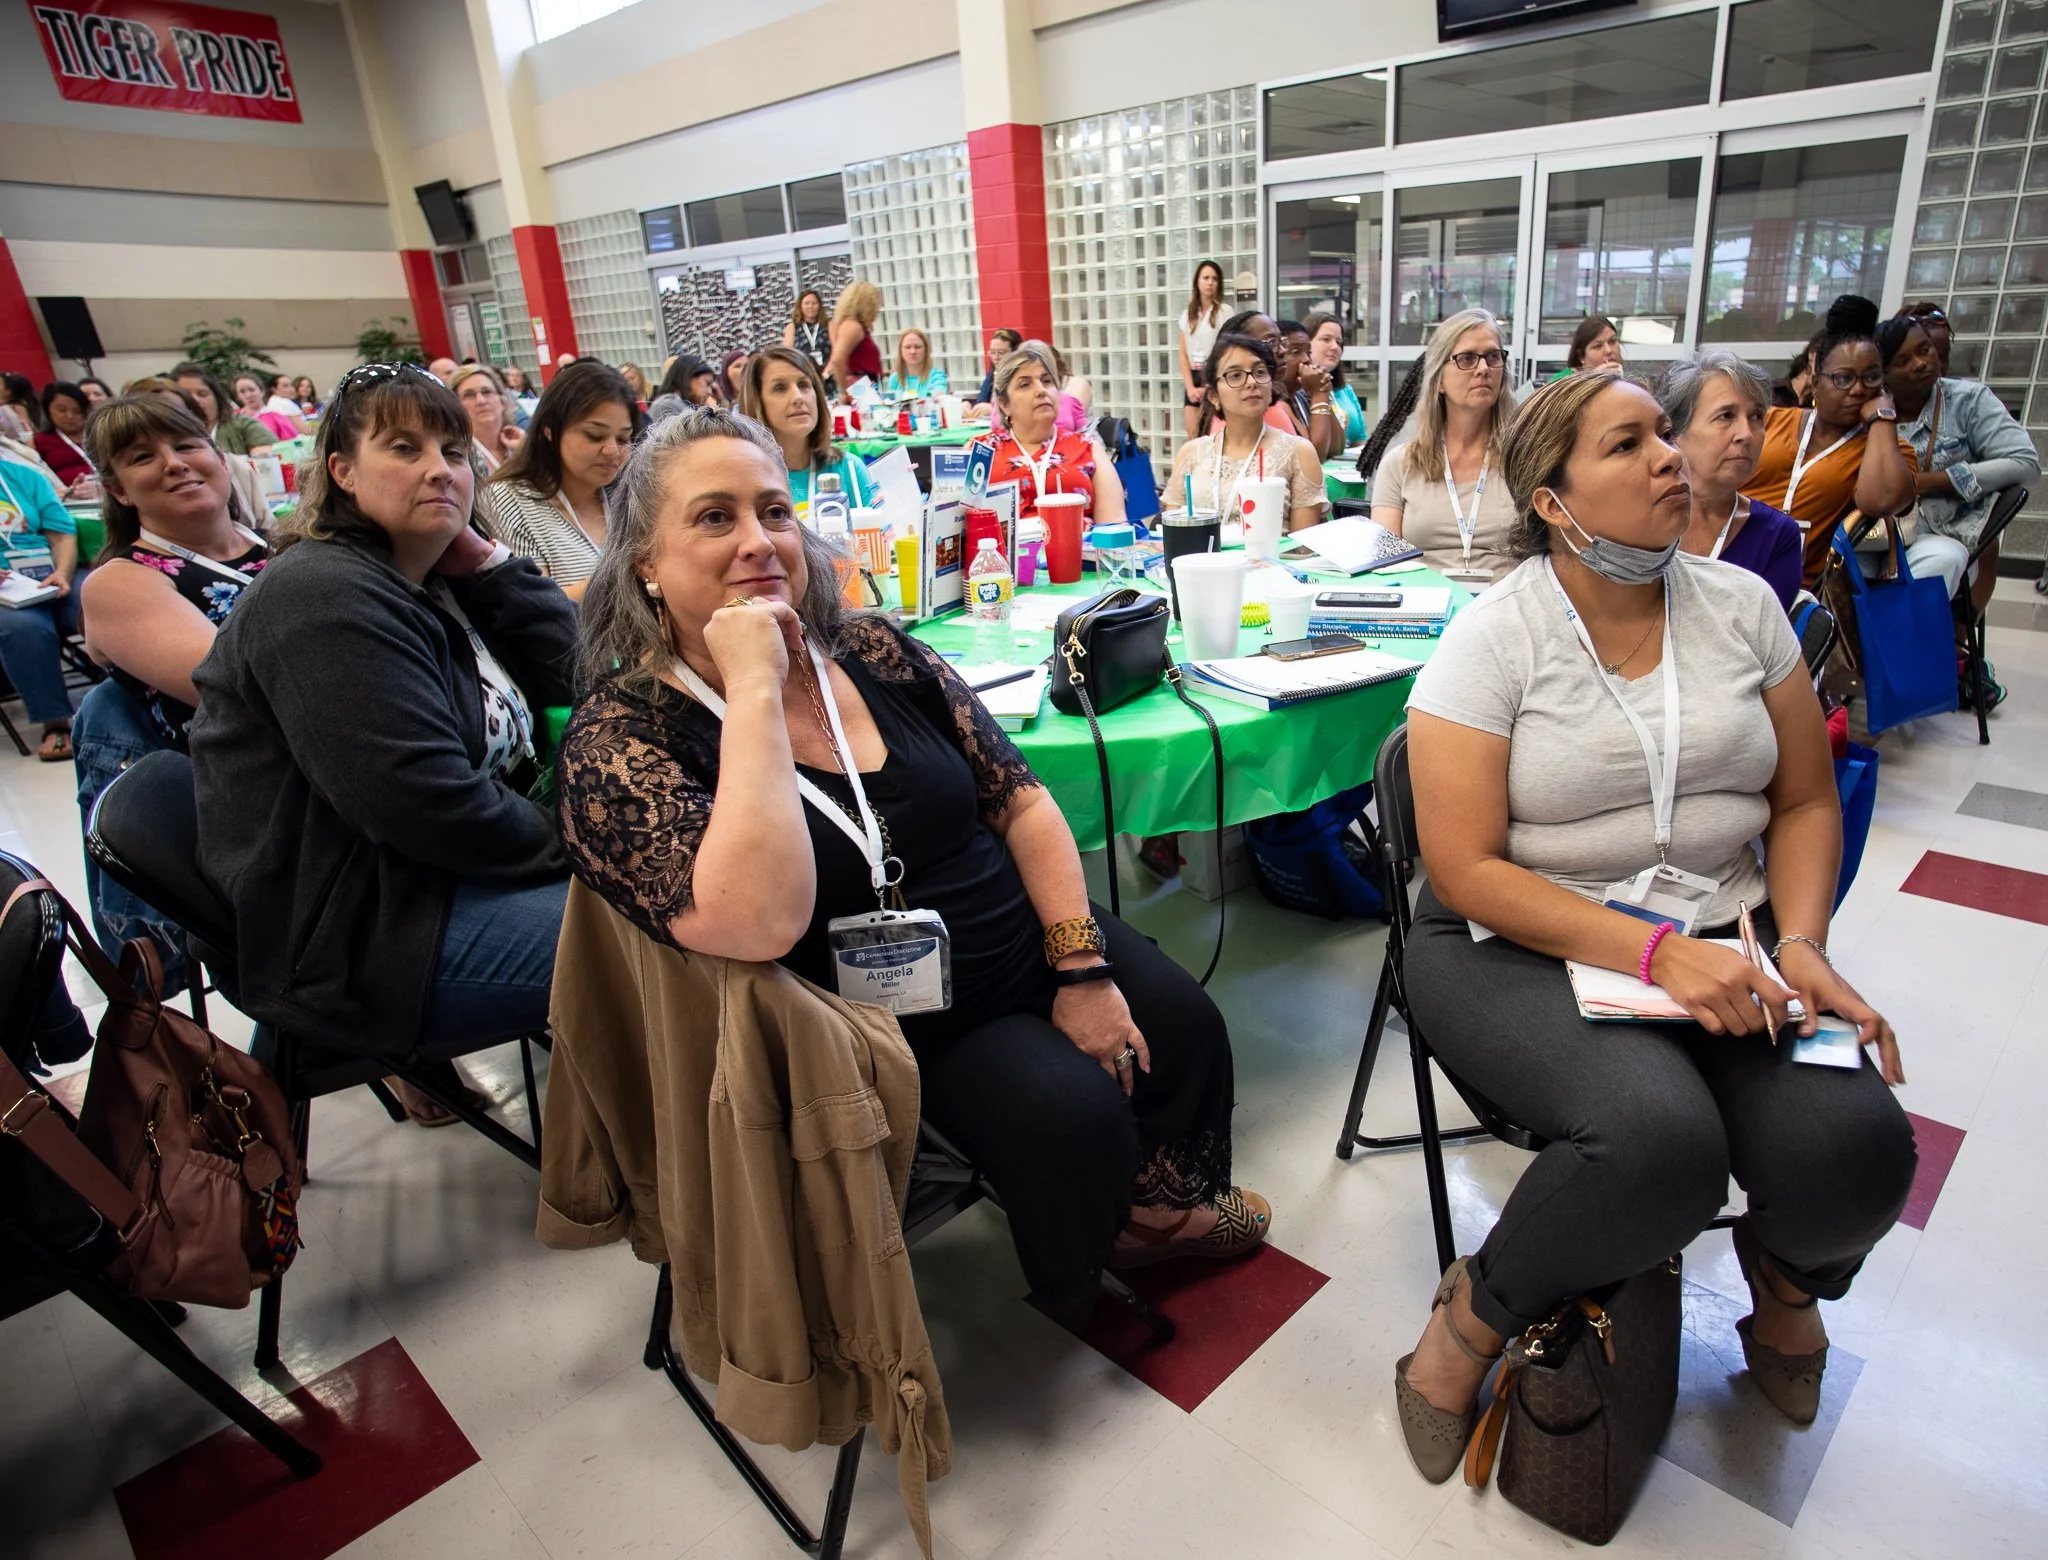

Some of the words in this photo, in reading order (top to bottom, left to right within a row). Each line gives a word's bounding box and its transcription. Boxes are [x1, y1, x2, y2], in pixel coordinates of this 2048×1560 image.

[34, 6, 175, 89] TIGER
[169, 26, 293, 101] PRIDE
[970, 462, 985, 494] 9
[866, 966, 913, 981] Angela
